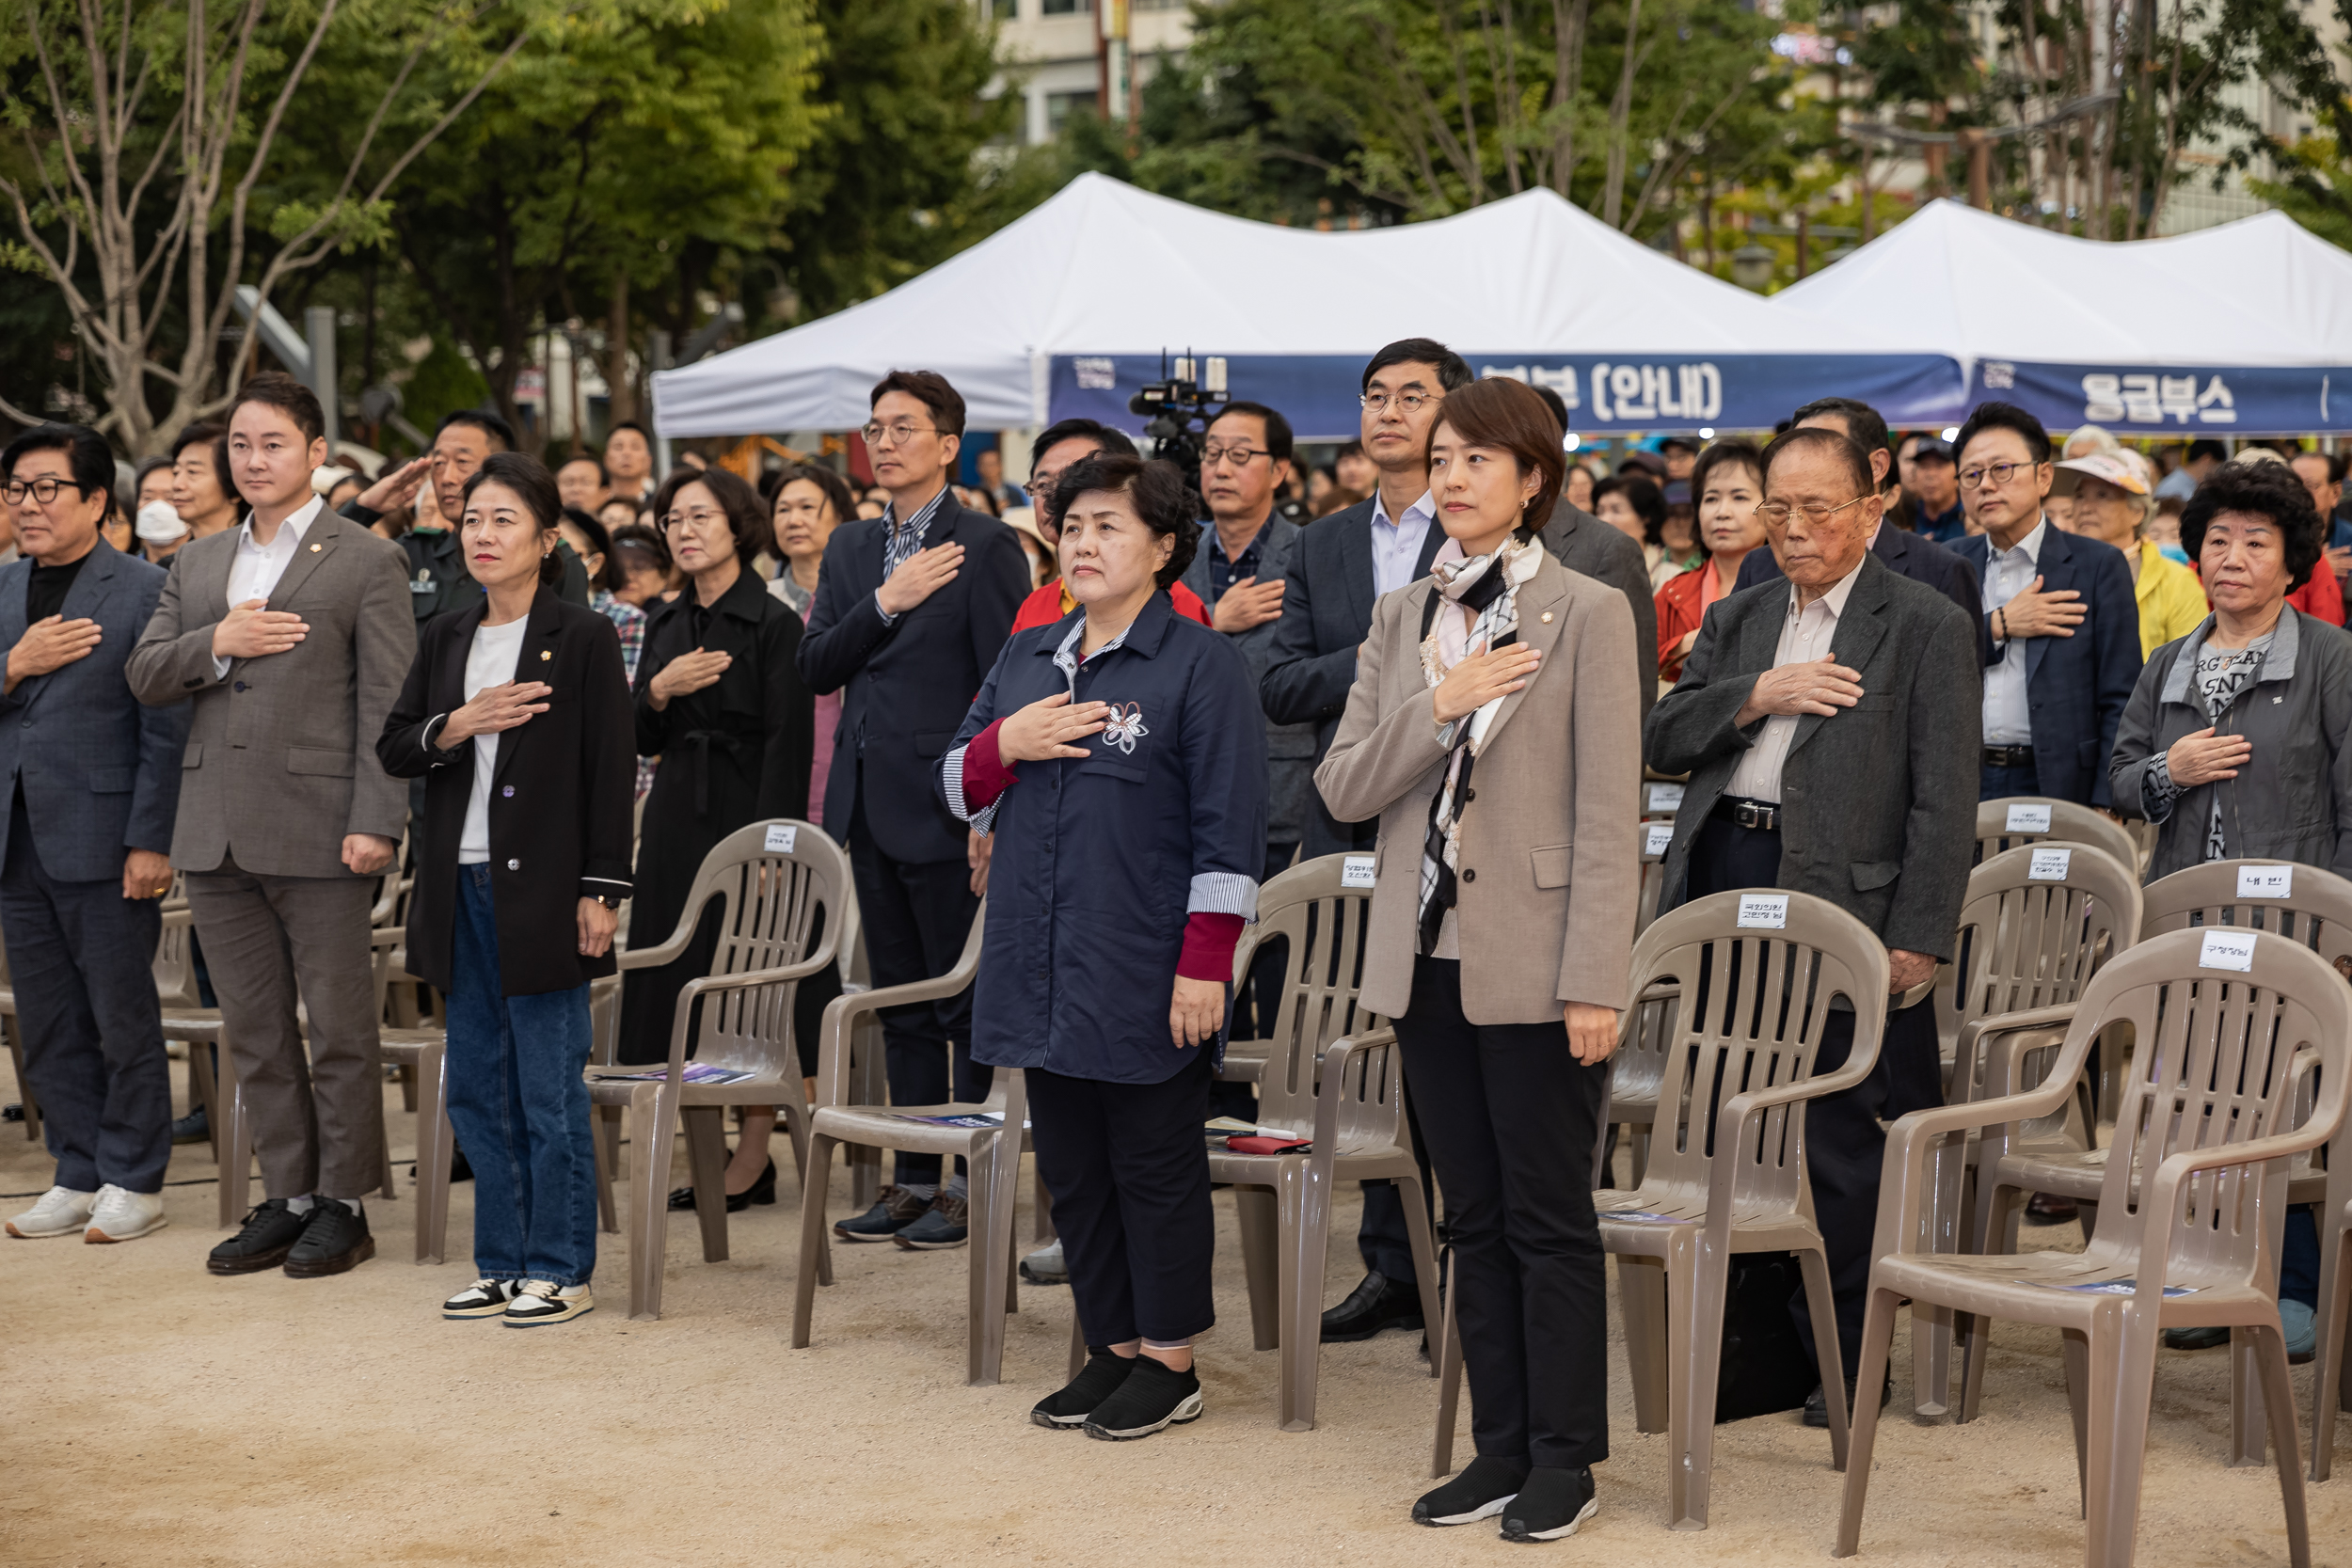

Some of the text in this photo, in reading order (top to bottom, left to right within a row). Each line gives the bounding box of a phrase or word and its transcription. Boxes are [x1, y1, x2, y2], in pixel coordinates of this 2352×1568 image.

[1591, 363, 1722, 422] (안내)
[1744, 903, 1783, 911] 국회의원
[2206, 944, 2249, 957] 구청장님
